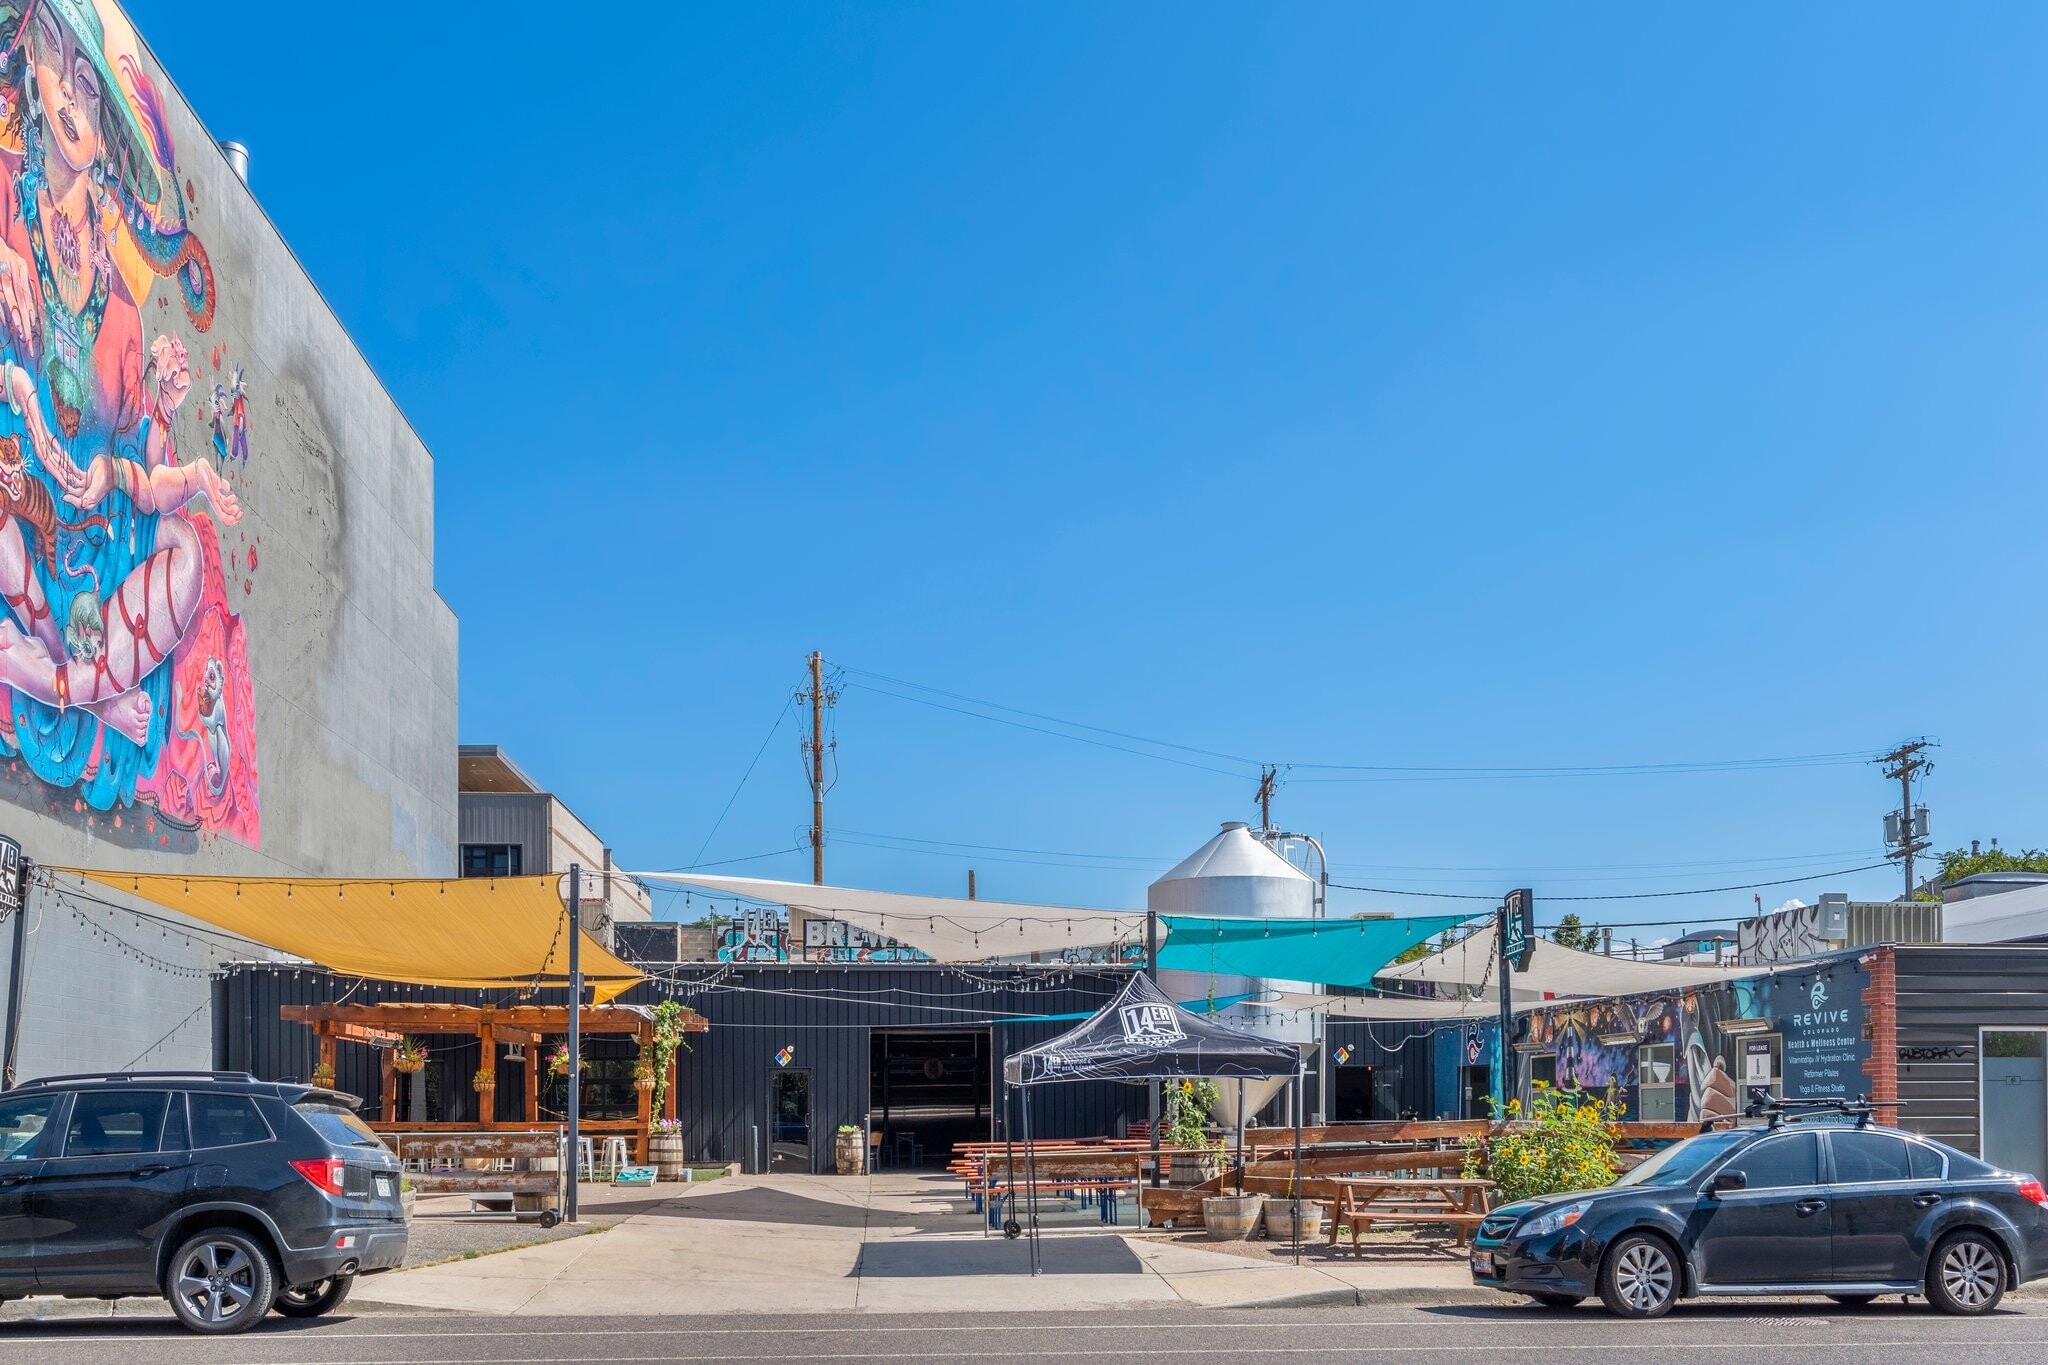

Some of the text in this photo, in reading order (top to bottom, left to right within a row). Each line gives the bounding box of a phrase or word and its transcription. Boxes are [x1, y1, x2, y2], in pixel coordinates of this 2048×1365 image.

[1127, 1006, 1170, 1034] 14ER
[1793, 1010, 1848, 1026] REVIVE
[1802, 1027, 1840, 1036] COLORADO
[1787, 1040, 1805, 1049] Health
[1811, 1038, 1836, 1048] Wellness
[1836, 1037, 1856, 1046] Center
[1842, 1053, 1856, 1062] Clinic
[1815, 1084, 1831, 1093] Fitness
[1831, 1083, 1846, 1092] Studio
